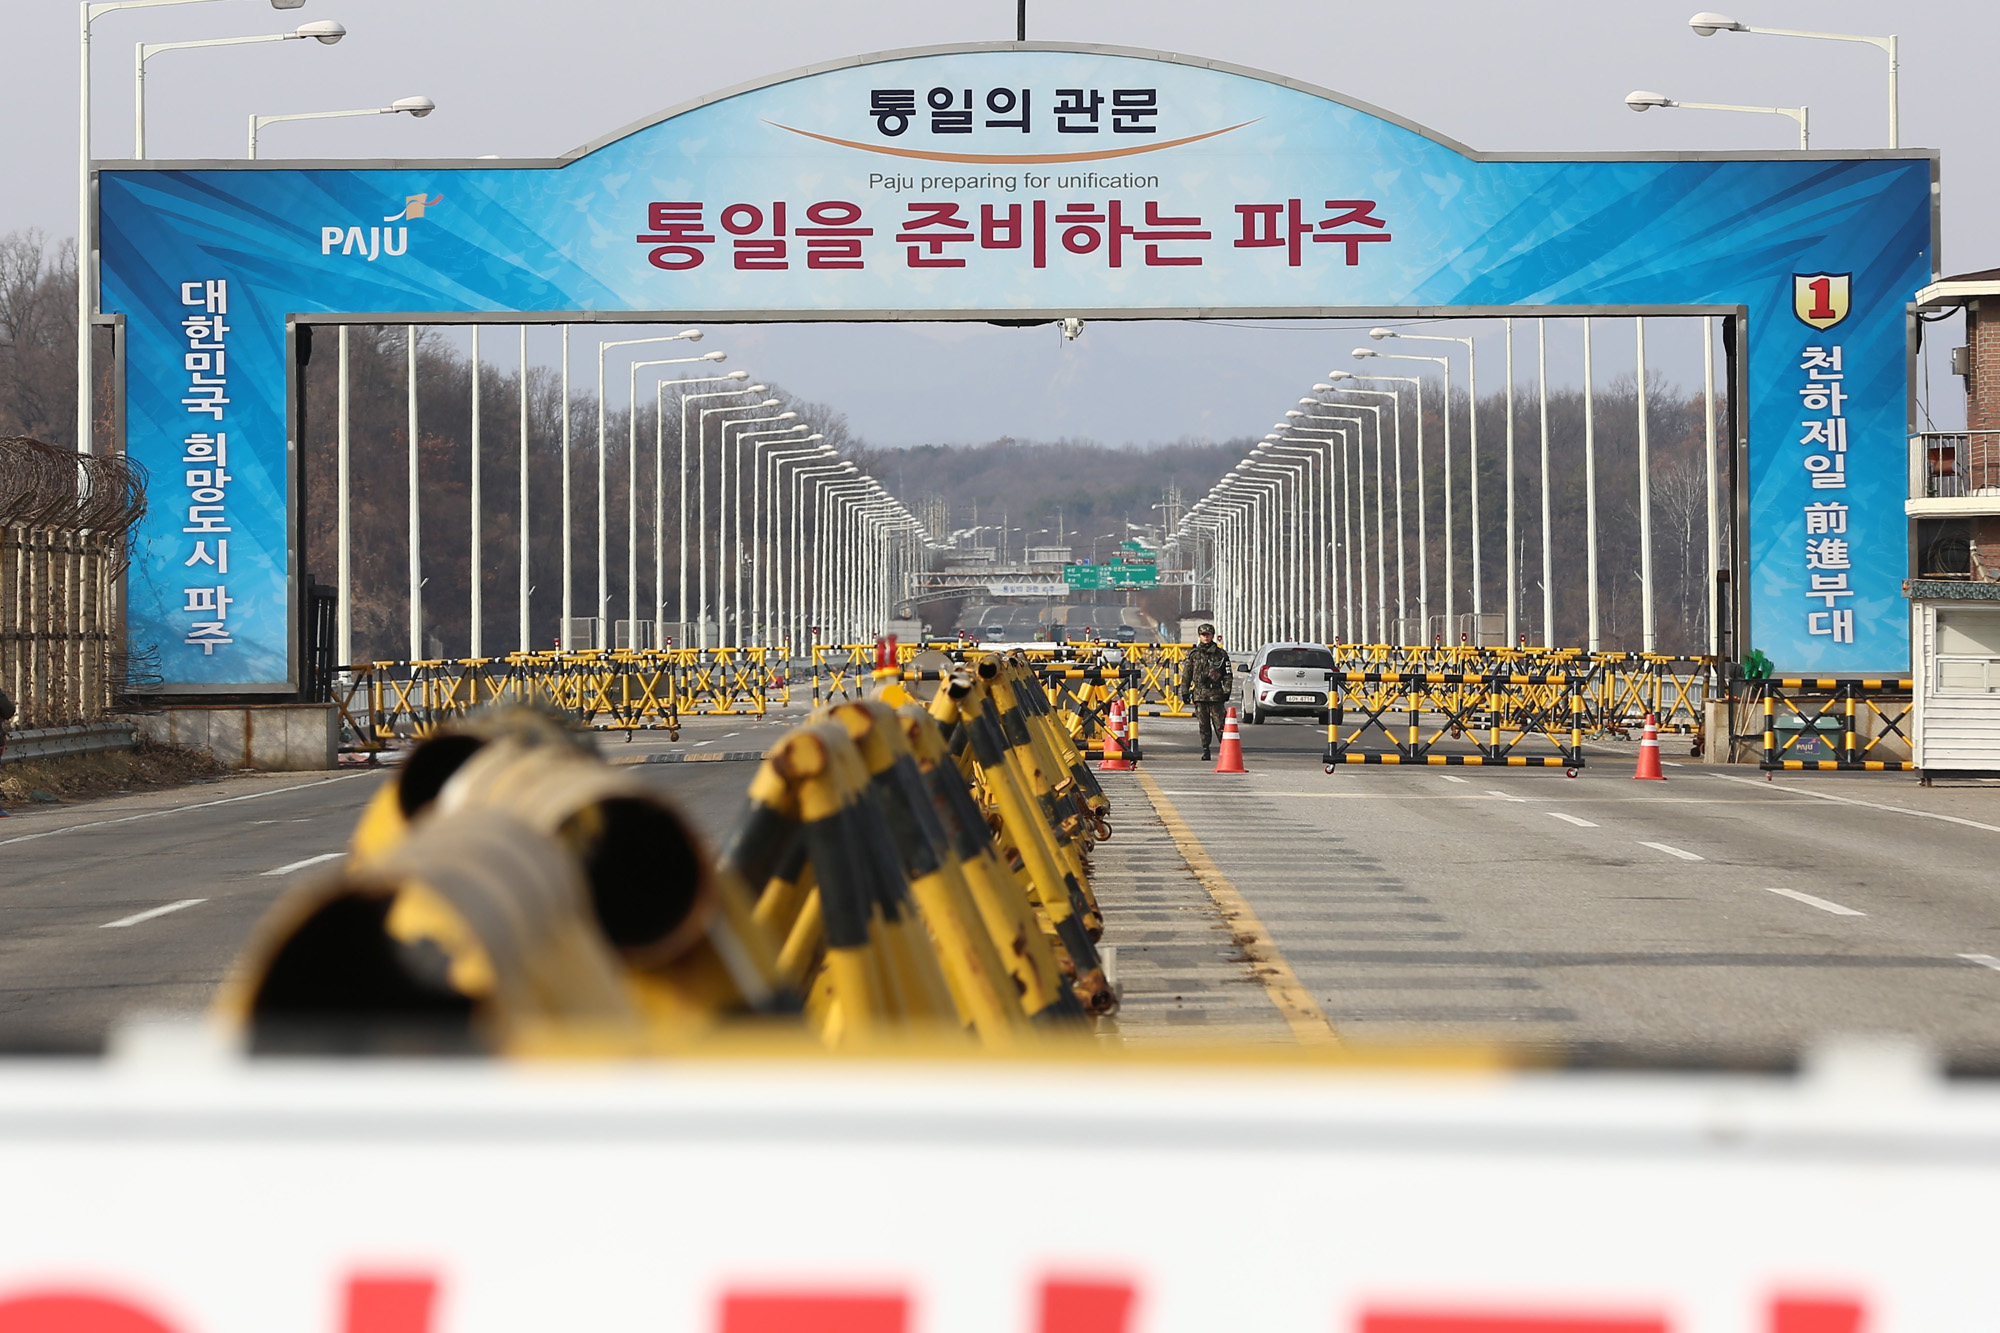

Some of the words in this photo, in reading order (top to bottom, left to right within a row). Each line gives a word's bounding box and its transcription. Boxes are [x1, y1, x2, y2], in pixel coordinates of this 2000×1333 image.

[870, 87, 1031, 136] 통일의
[1053, 87, 1158, 134] 관문
[870, 172, 914, 193] Paju
[921, 172, 1017, 193] preparing
[1024, 172, 1051, 189] for
[1057, 172, 1159, 189] unification
[321, 226, 408, 262] PAJU
[636, 200, 874, 270] 통일을
[895, 199, 1211, 268] 준비하는
[1233, 198, 1391, 266] 파주
[1807, 278, 1836, 318] 1
[180, 279, 230, 421] 대한민국
[1799, 345, 1848, 489] 천하제일
[181, 432, 232, 574] 희망도시
[1804, 501, 1854, 644] 前進부대
[183, 585, 233, 655] 파주
[1796, 743, 1813, 751] PAJU
